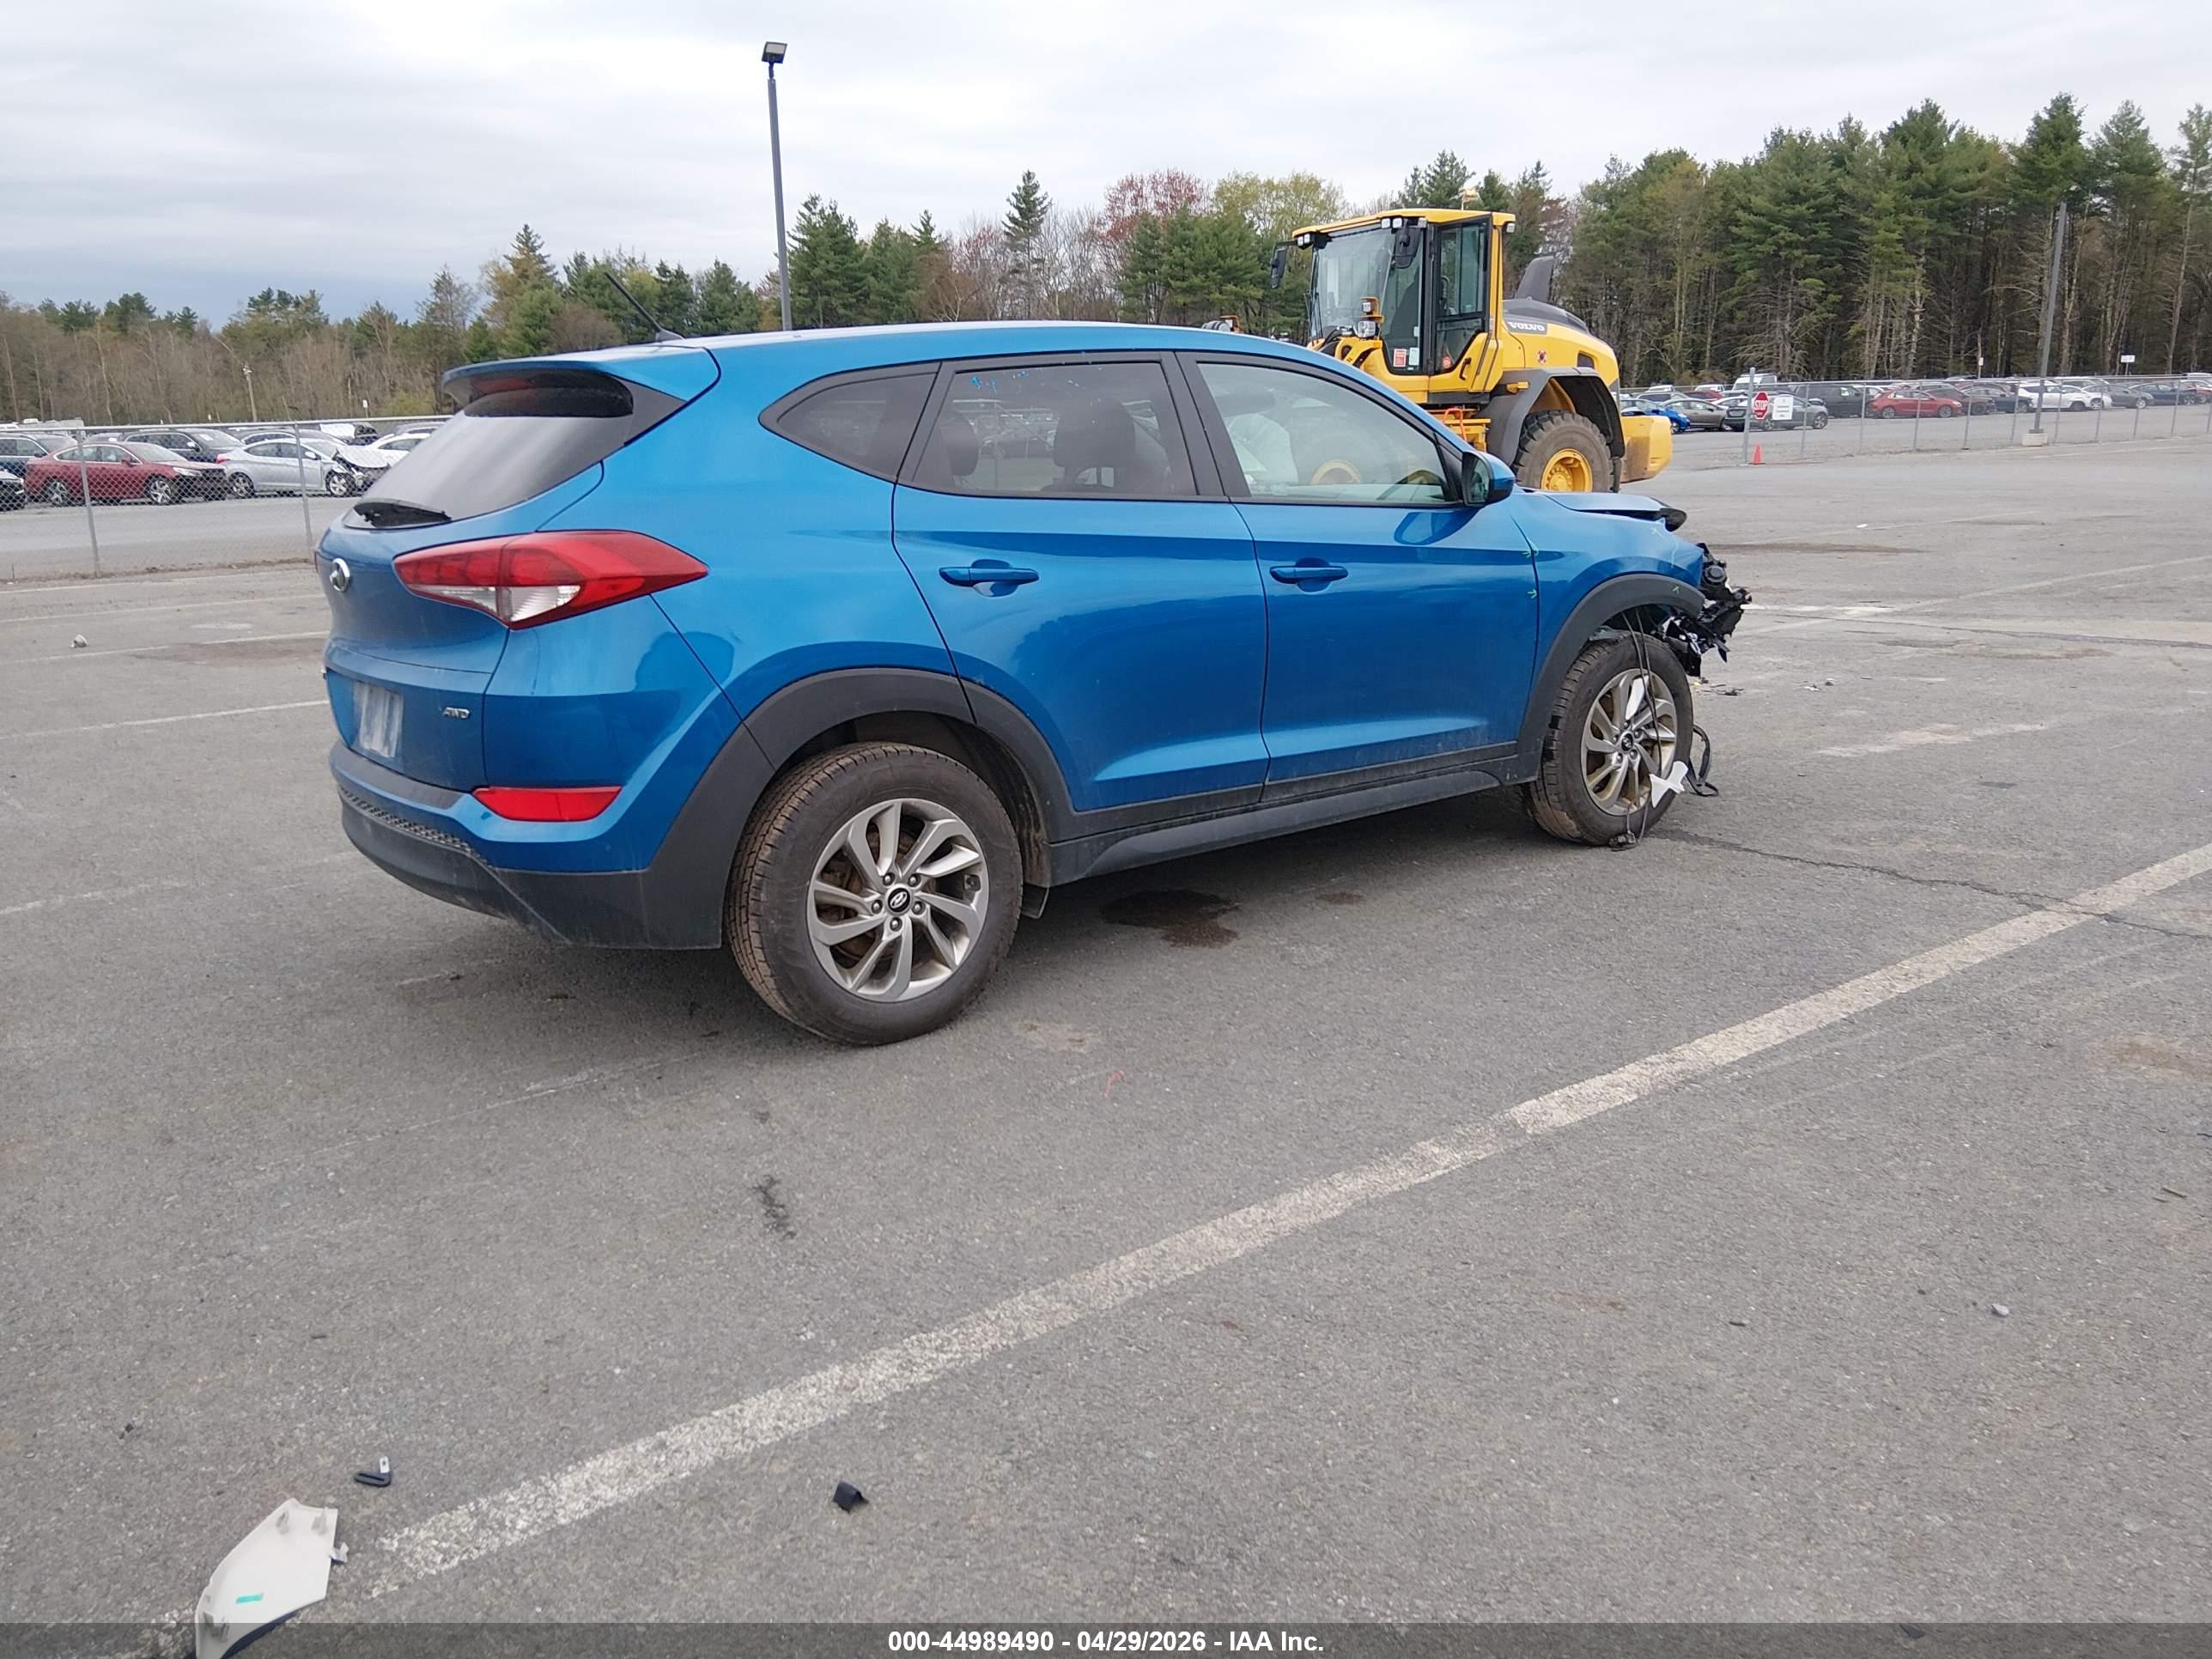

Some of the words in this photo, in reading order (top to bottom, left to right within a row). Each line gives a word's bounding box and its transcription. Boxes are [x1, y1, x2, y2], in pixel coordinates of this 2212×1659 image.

[1507, 321, 1546, 331] VOLVO
[1754, 399, 1768, 410] STOP
[442, 707, 470, 719] AWD
